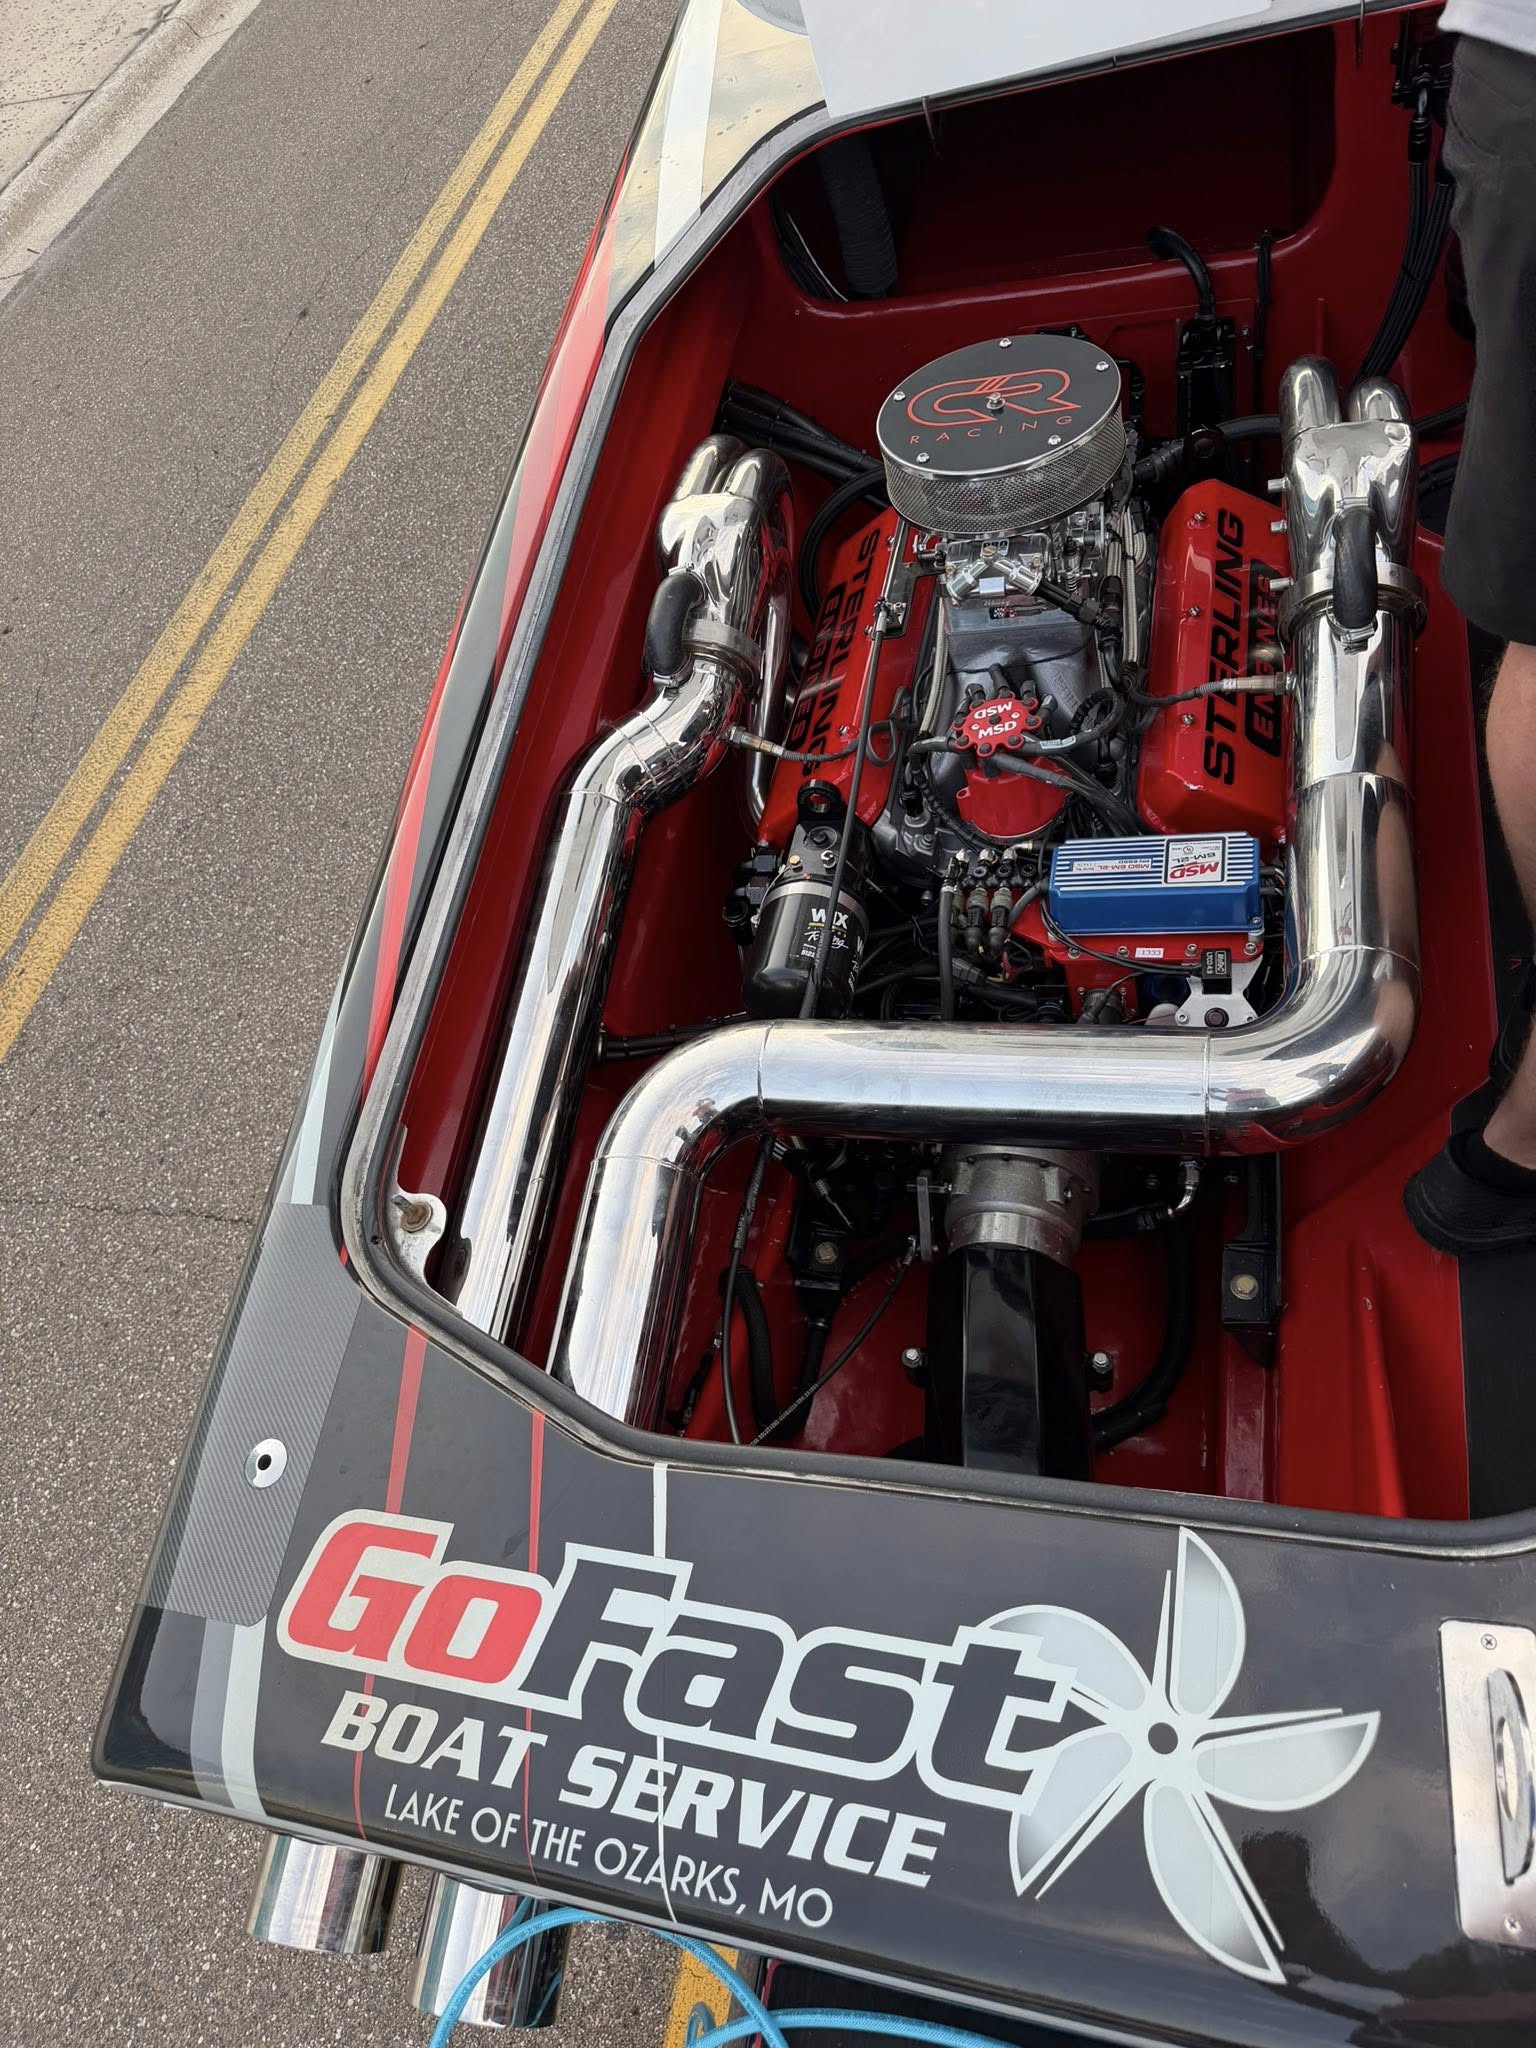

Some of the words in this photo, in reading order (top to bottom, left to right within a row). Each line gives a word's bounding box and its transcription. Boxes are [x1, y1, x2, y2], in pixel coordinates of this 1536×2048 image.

[909, 415, 1073, 444] RACING
[802, 528, 881, 778] STERLING
[1203, 509, 1245, 785] STERLING
[973, 701, 1013, 719] MSD
[977, 720, 1017, 739] MSD
[1168, 861, 1220, 880] MSD
[320, 1690, 549, 1790] BOAT
[558, 1743, 946, 1888] SERVICE
[384, 1783, 464, 1837] LAKE
[470, 1806, 523, 1851] OF
[529, 1817, 586, 1867] THE
[594, 1837, 746, 1913] OZARKS,
[759, 1876, 833, 1928] MO
